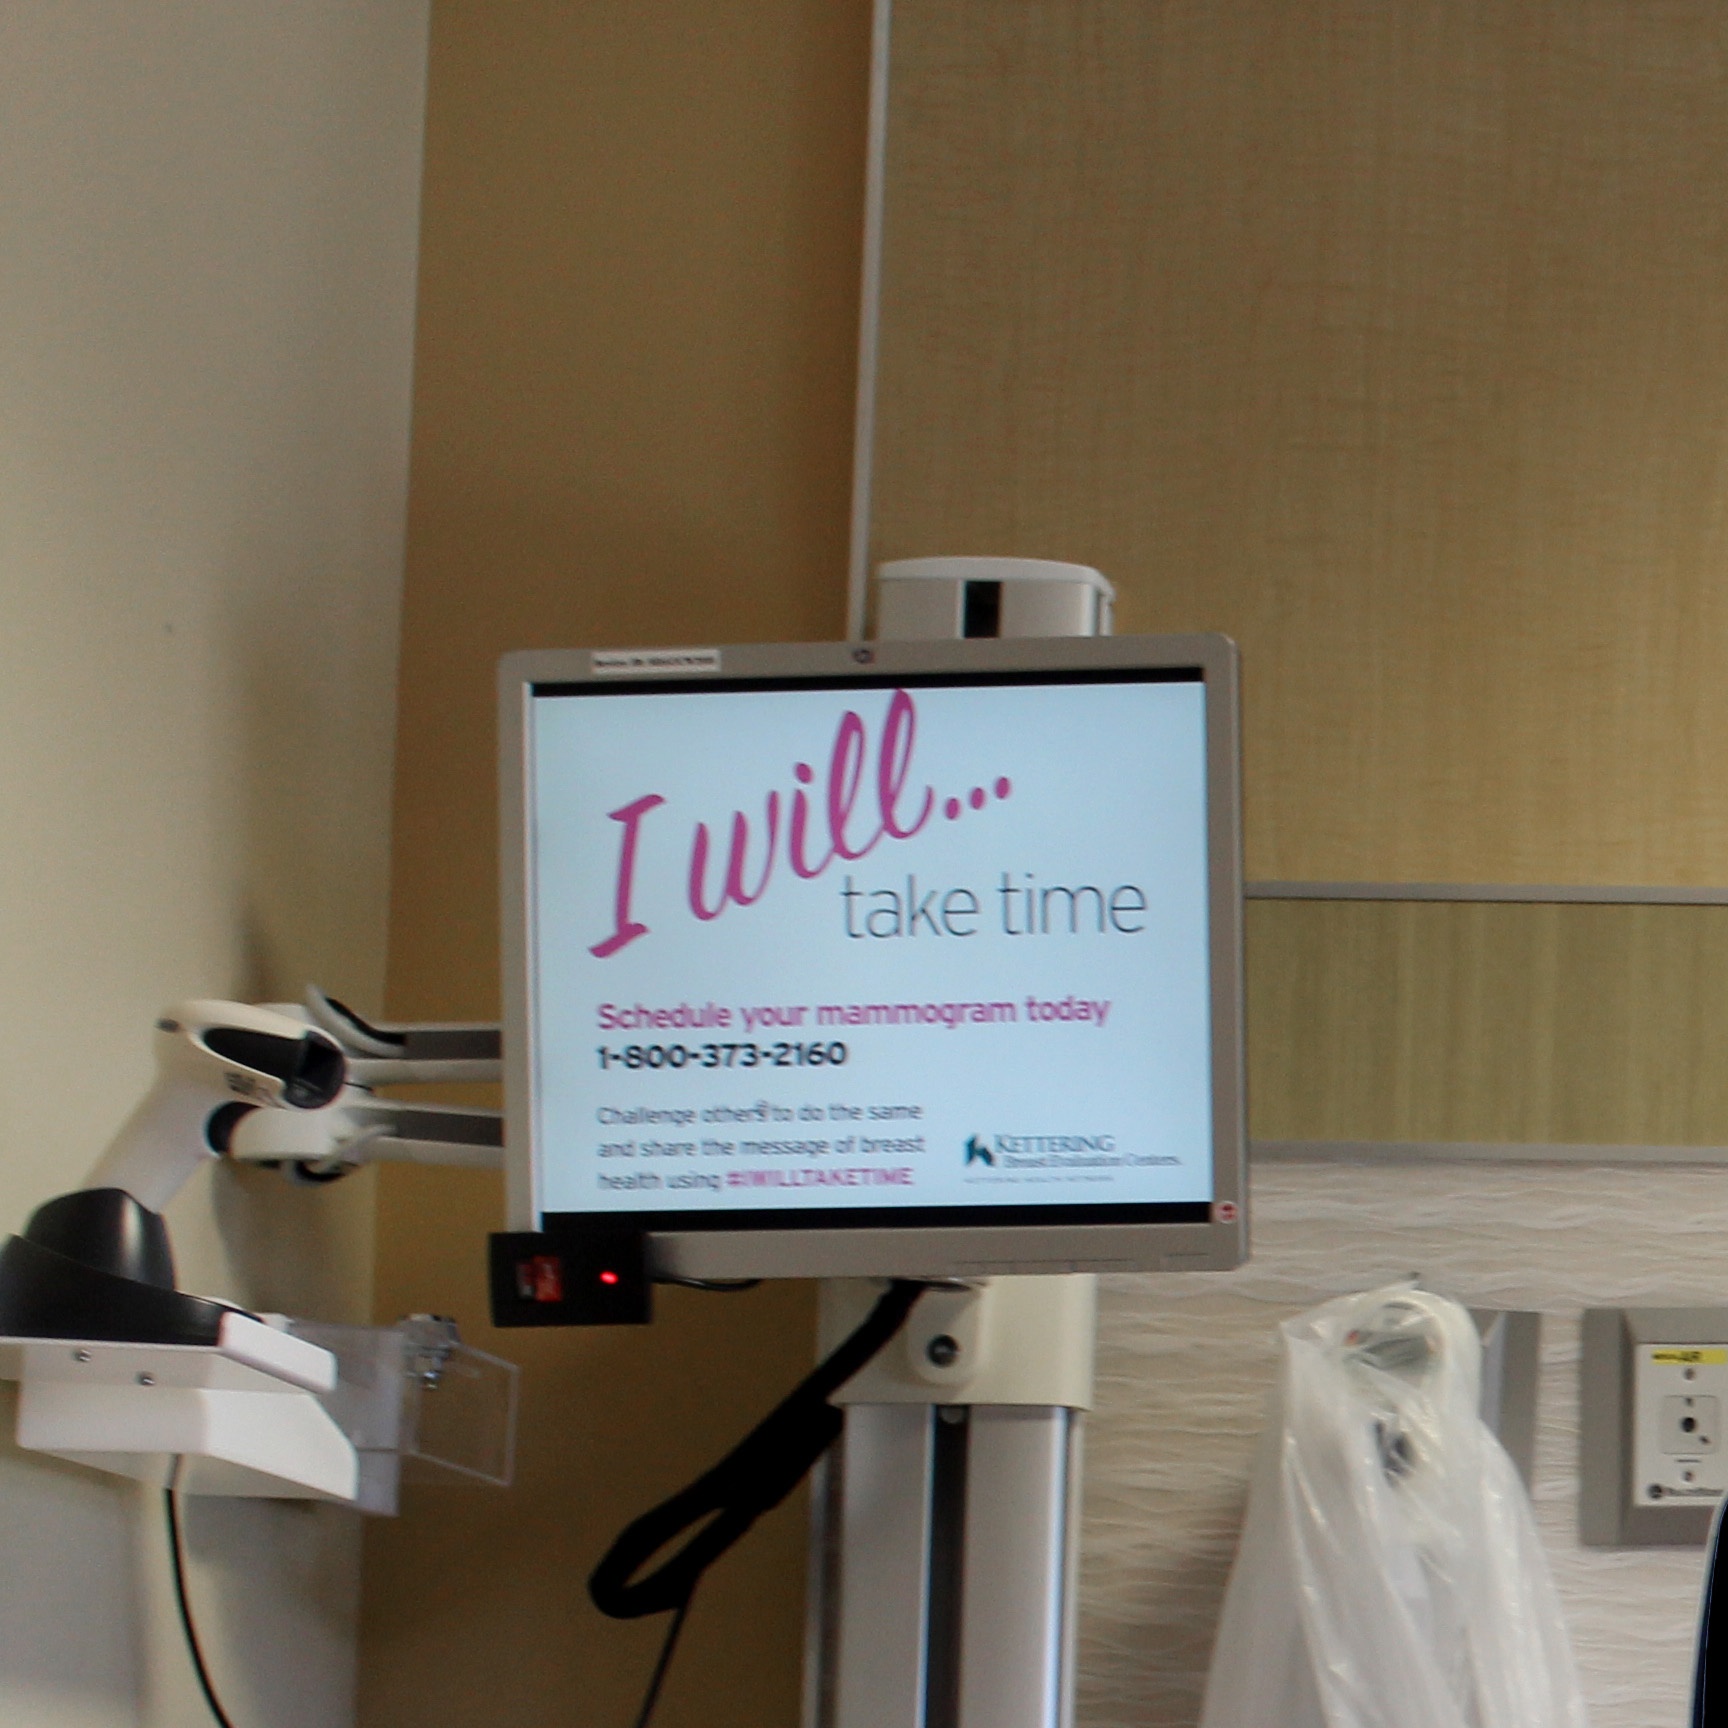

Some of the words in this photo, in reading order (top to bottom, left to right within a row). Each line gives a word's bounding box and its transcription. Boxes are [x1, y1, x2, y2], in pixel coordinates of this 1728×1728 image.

[588, 793, 667, 959] I
[687, 687, 1011, 921] will...
[839, 873, 981, 940] take
[997, 871, 1148, 937] time
[598, 1001, 732, 1031] Schedule
[740, 1004, 809, 1034] your
[816, 1000, 1019, 1030] mammogram
[1024, 995, 1112, 1028] today
[598, 1041, 848, 1070] 1-800-373-2160
[598, 1105, 697, 1127] Challenge
[771, 1105, 794, 1122] to
[799, 1104, 826, 1122] do
[828, 1104, 864, 1121] the
[867, 1104, 923, 1121] same
[599, 1139, 636, 1158] and
[639, 1139, 698, 1158] share
[701, 1138, 735, 1157] the
[740, 1138, 831, 1159] message
[834, 1134, 857, 1154] of
[860, 1134, 926, 1154] breast
[598, 1171, 662, 1191] health
[666, 1171, 722, 1193] using
